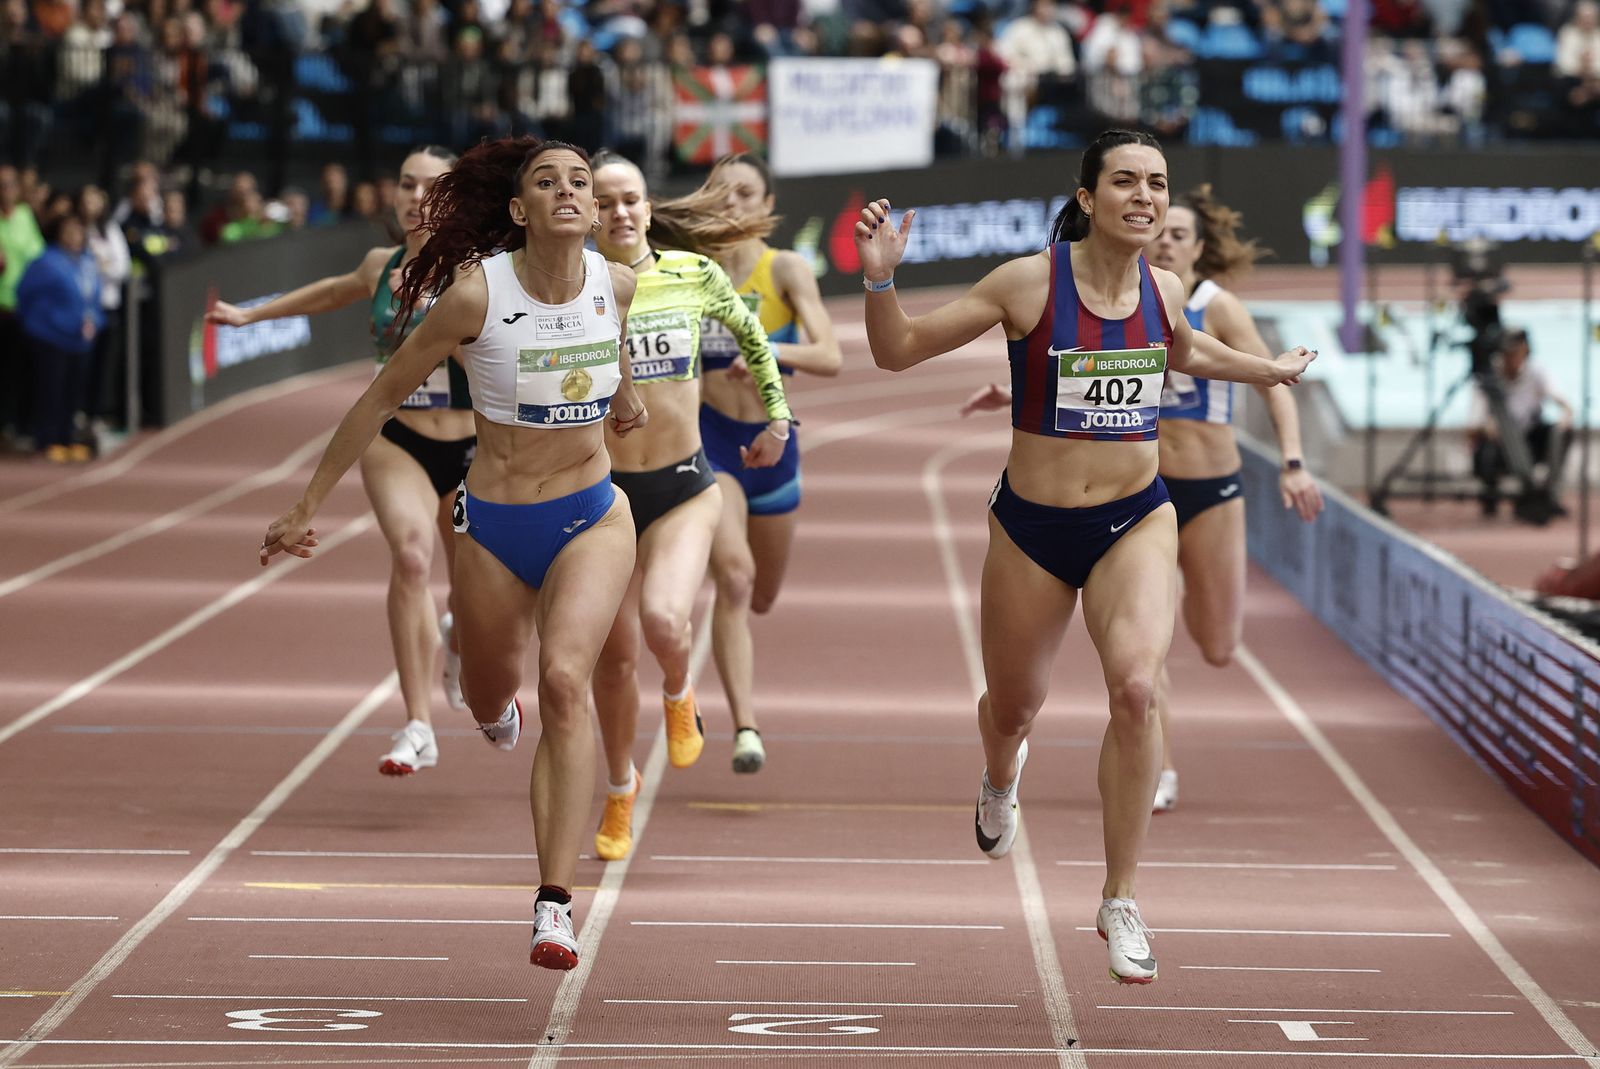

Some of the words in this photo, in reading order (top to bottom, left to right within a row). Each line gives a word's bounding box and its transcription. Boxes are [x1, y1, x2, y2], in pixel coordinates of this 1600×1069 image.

[560, 349, 611, 364] IBERDROLA
[1097, 358, 1157, 370] IBERDROLA
[632, 360, 675, 377] oma
[1084, 378, 1143, 406] 402
[225, 1008, 383, 1031] 3
[728, 1013, 884, 1035] 2
